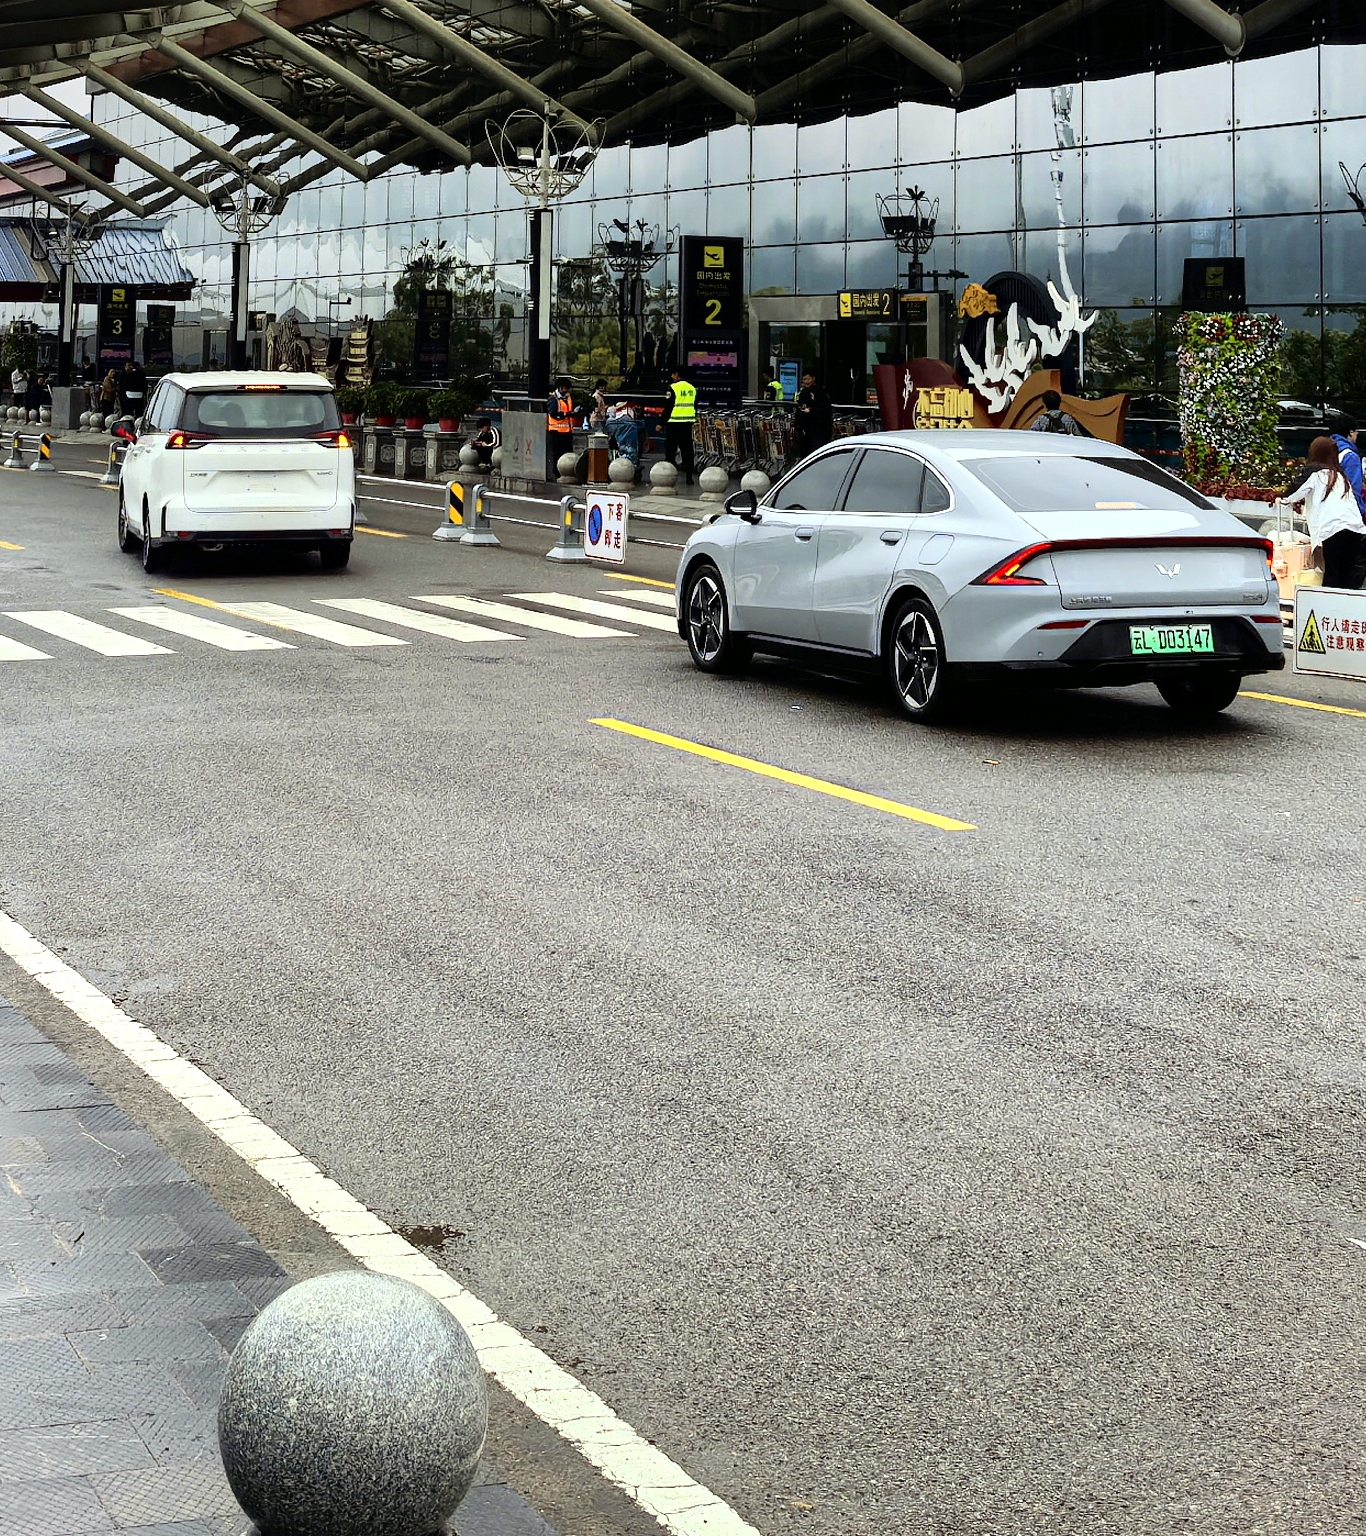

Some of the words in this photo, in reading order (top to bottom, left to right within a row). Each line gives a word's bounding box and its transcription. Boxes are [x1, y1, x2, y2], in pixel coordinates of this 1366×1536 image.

[705, 299, 722, 325] 2
[882, 292, 891, 315] 2
[112, 319, 123, 335] 3
